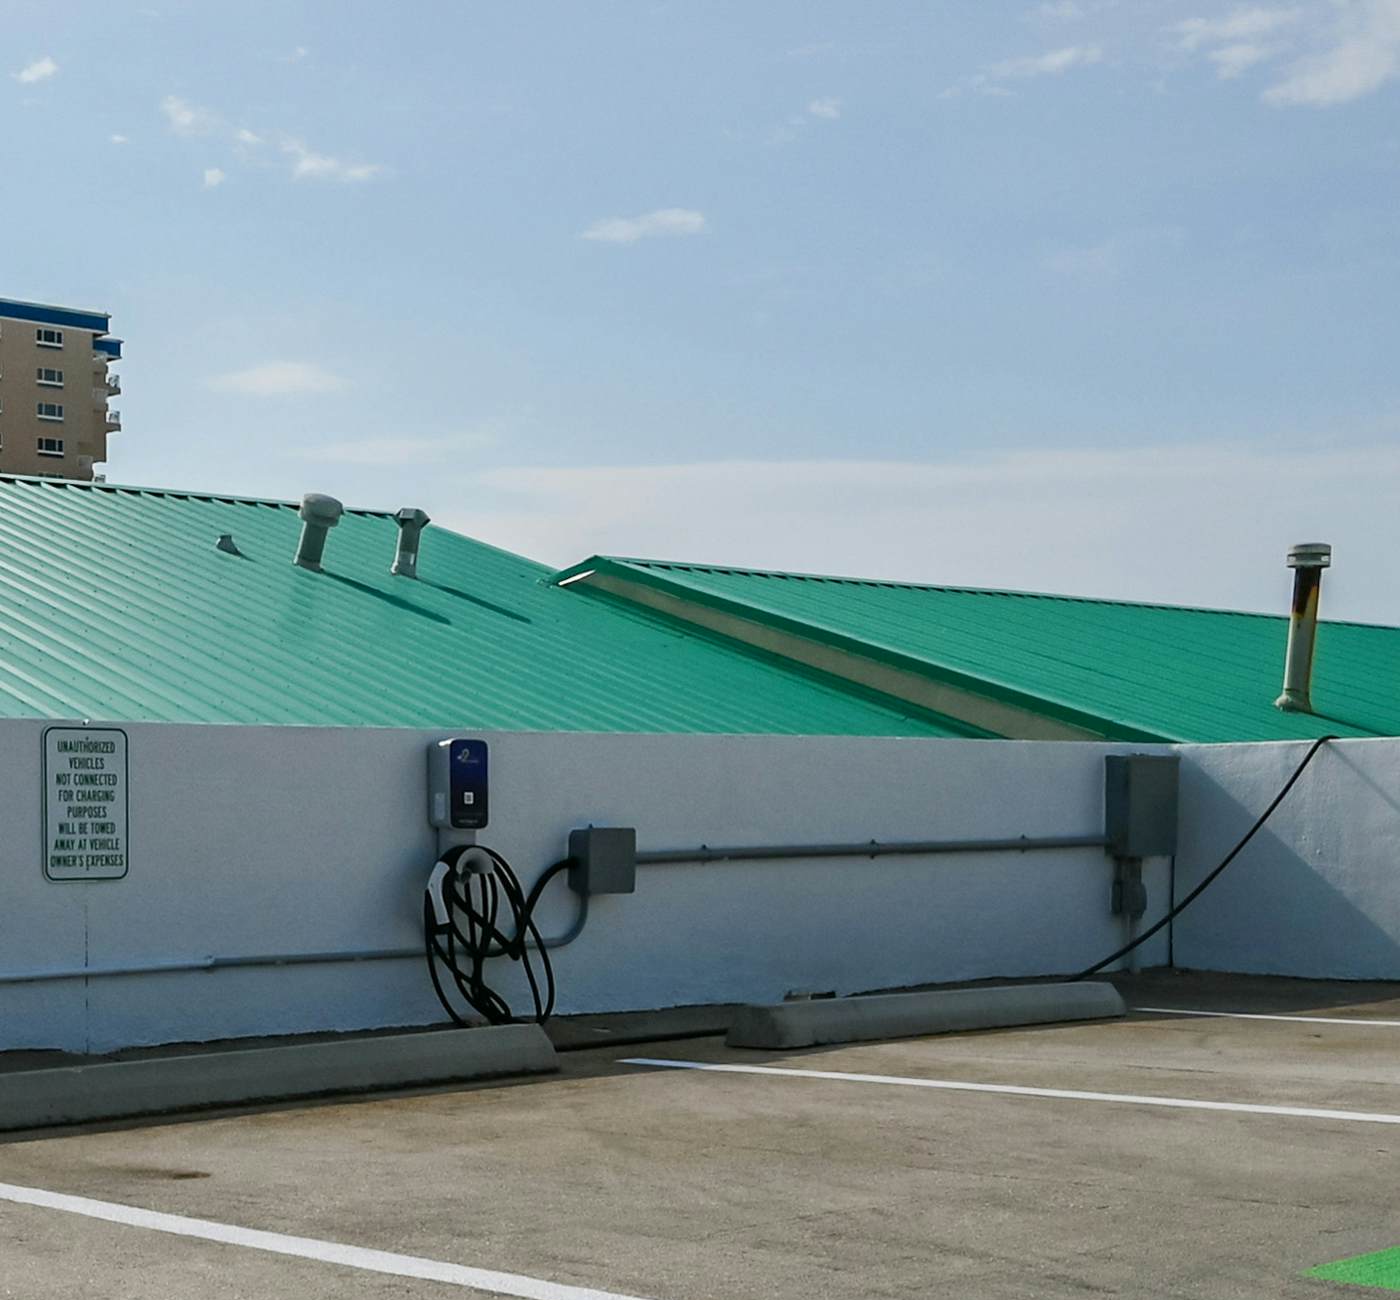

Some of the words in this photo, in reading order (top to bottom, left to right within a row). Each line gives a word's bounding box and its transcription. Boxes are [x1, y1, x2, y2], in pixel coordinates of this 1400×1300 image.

[58, 741, 115, 753] UNAUTHORIZED
[69, 758, 104, 769] VEHICLES
[56, 774, 70, 785] NOT
[74, 774, 117, 786] CONNECTED
[58, 790, 73, 802] FOR
[76, 790, 115, 802] CHARGING
[67, 806, 107, 818] PURPOSES
[59, 823, 76, 834] WILL
[79, 823, 88, 834] BE
[91, 823, 115, 834] TOWED
[54, 839, 75, 850] AWAY
[78, 839, 87, 850] AT
[90, 839, 120, 850] VEHICLE
[86, 855, 124, 867] EXPENSES
